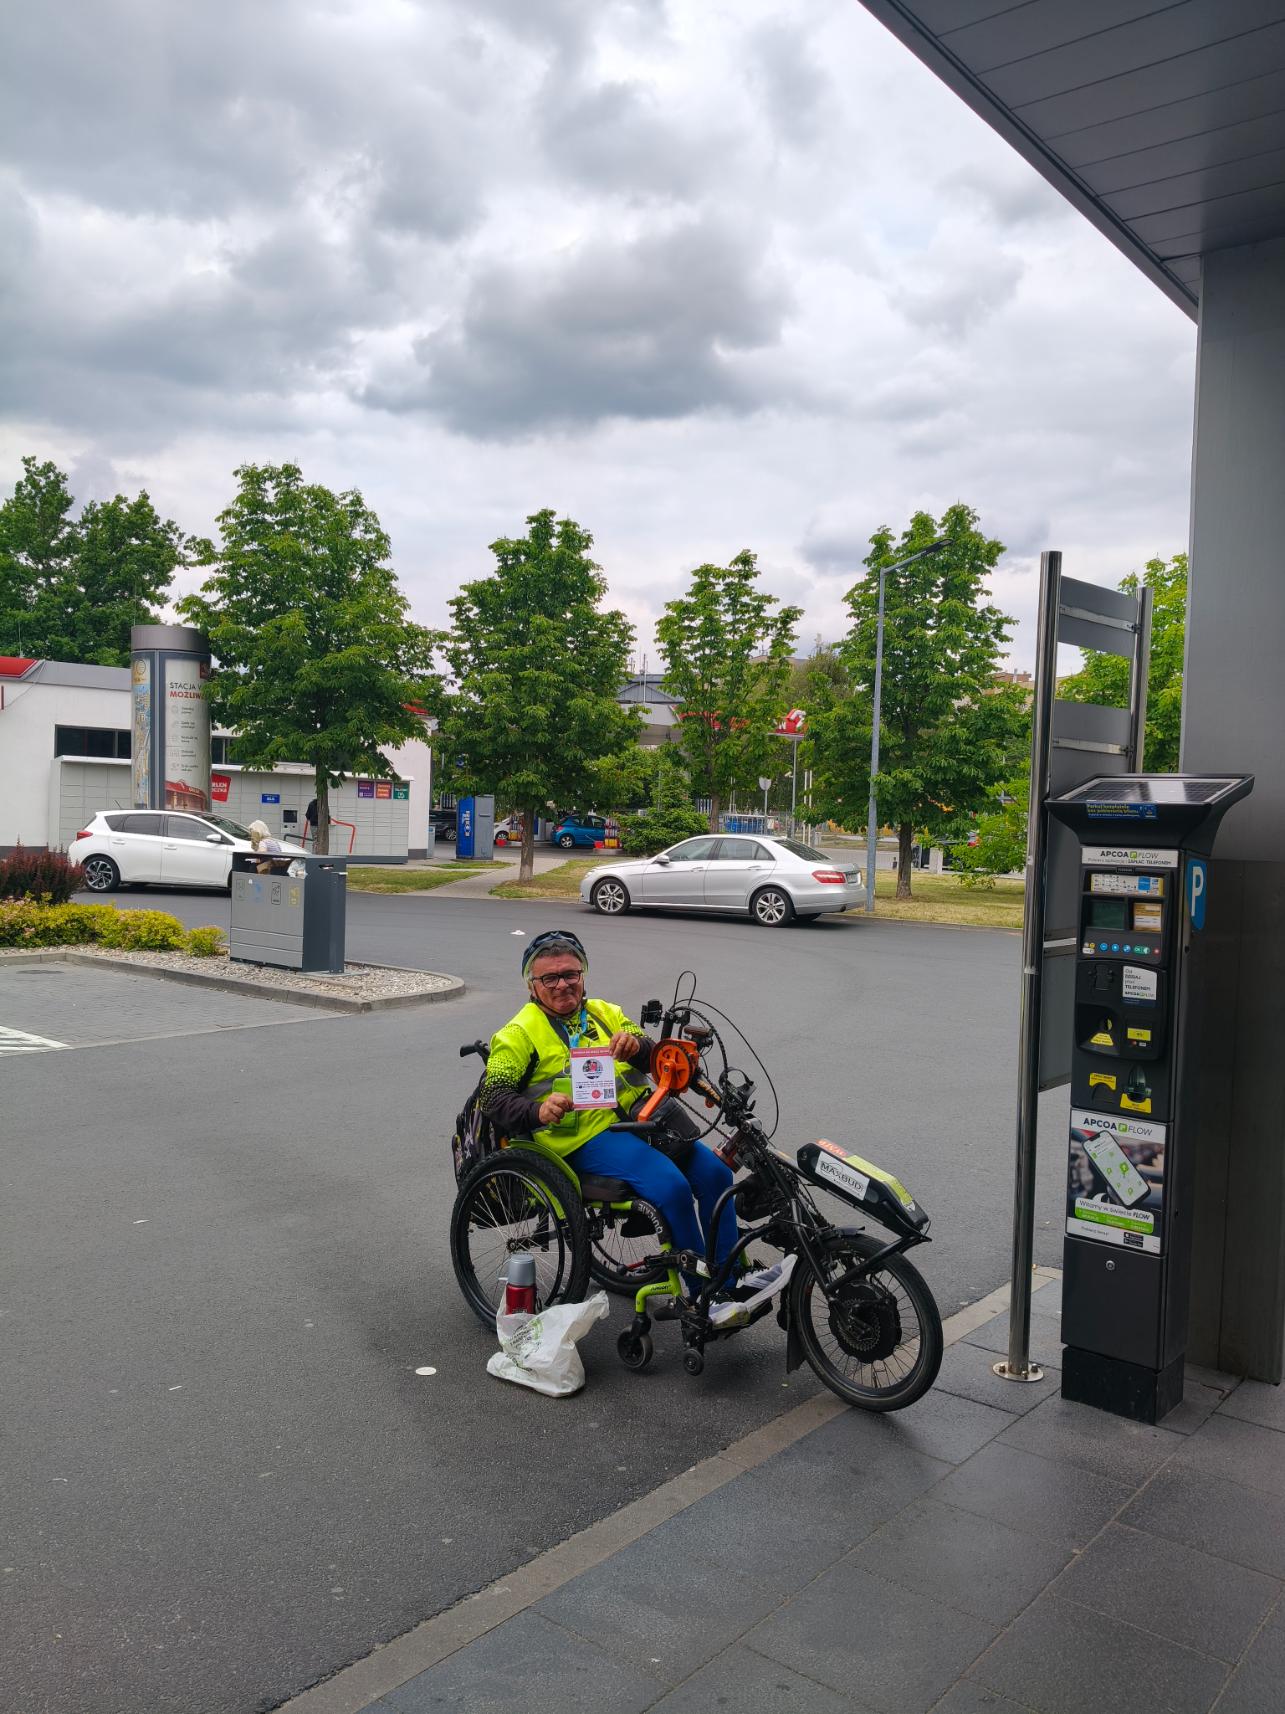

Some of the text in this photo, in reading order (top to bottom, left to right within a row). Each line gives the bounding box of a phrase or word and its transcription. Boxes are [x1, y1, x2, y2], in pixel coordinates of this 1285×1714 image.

[169, 682, 197, 690] STACJA
[1100, 850, 1129, 858] APCOA
[1191, 866, 1204, 917] P
[1083, 1117, 1152, 1136] APCOA FLOW
[1132, 1211, 1151, 1220] FLOW
